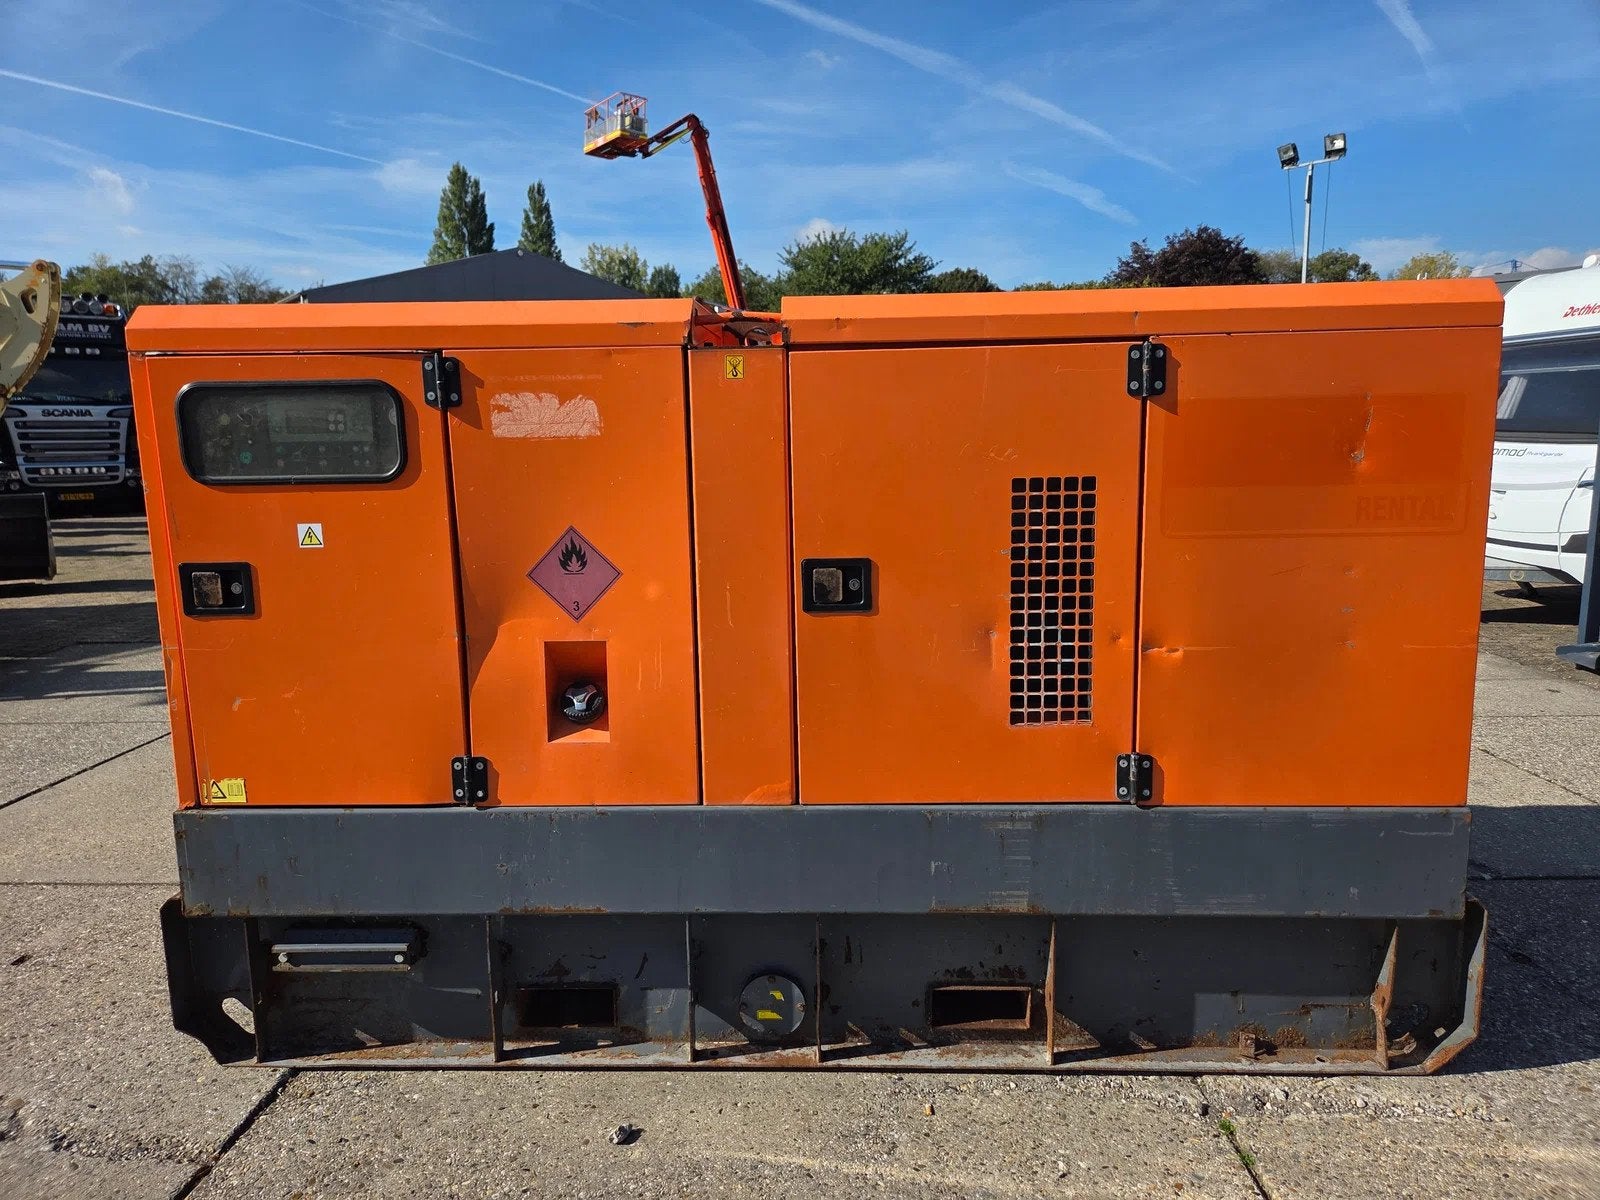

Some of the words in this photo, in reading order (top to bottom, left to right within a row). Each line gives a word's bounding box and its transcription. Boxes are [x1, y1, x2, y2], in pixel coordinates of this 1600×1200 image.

[41, 408, 93, 417] SCANIA
[1356, 496, 1452, 521] RENTAL
[573, 601, 580, 611] 3
